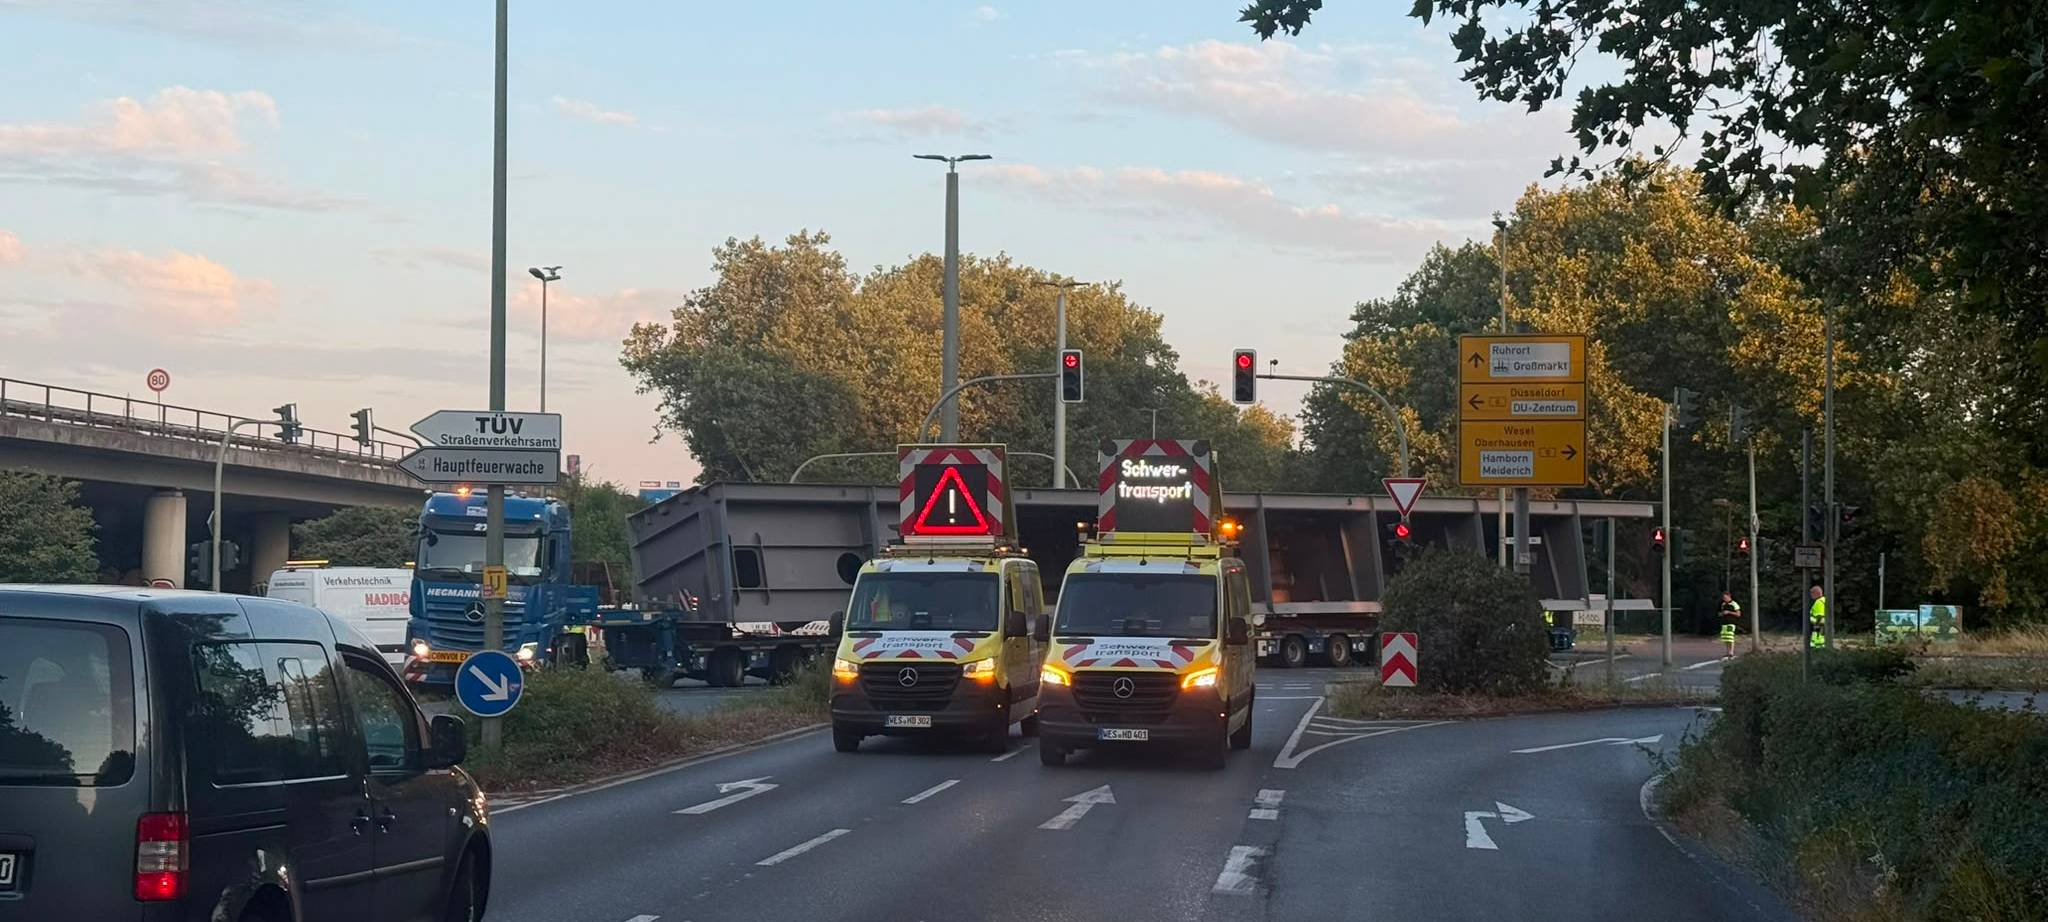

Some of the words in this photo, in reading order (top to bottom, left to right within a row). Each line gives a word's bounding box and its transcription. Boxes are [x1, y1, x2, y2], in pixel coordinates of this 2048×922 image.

[1492, 346, 1530, 355] Ruhrort
[1513, 361, 1568, 371] Großmarkt
[152, 375, 165, 385] 80
[1510, 388, 1565, 397] Düsseldorf
[1513, 403, 1576, 413] DU-Zentrum
[475, 414, 523, 434] TÜV
[1504, 426, 1534, 435] Wesel
[440, 434, 557, 448] Straßenverkehrsamt
[1474, 438, 1535, 447] Oberhausen
[1482, 453, 1529, 463] Hamborn
[433, 457, 544, 477] Hauptfeuerwache
[1121, 459, 1187, 477] Schwer-
[1482, 465, 1531, 475] Meiderich
[1118, 480, 1193, 503] transport
[323, 576, 392, 586] Verkehrstechnik
[1133, 730, 1147, 739] 401
